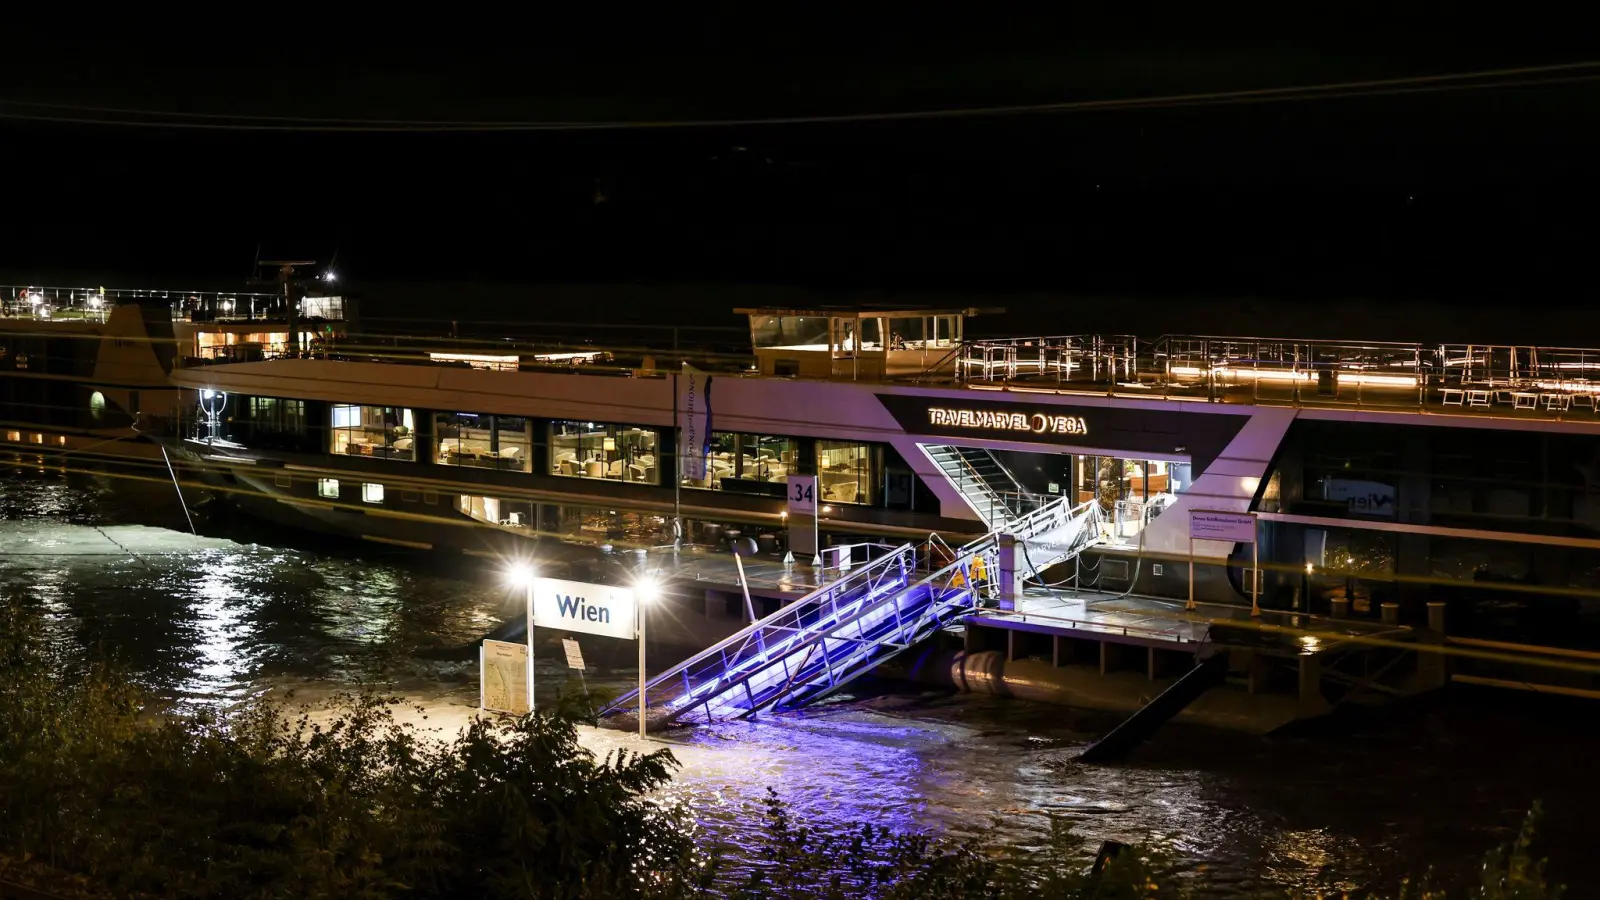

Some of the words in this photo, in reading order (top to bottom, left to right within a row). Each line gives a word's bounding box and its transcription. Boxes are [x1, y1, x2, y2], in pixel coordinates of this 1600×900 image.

[928, 407, 1031, 431] TRAVELMARVEL
[1048, 415, 1088, 435] VEGA
[795, 484, 813, 503] 34
[556, 594, 610, 623] Wien
